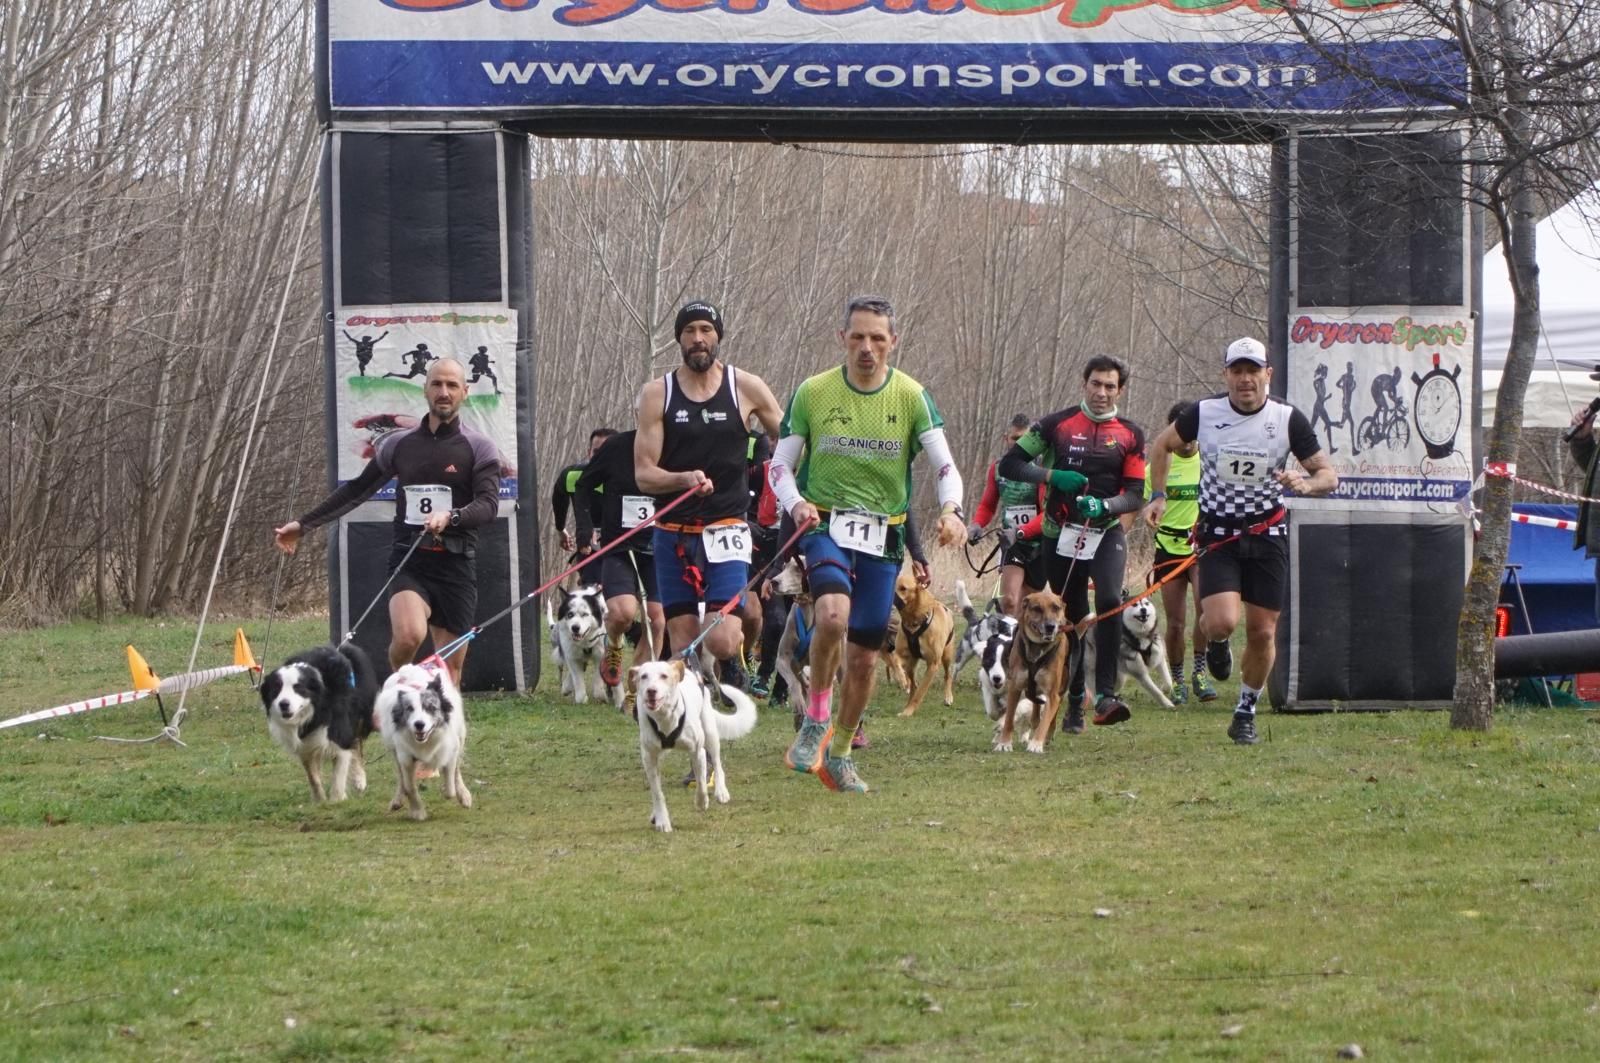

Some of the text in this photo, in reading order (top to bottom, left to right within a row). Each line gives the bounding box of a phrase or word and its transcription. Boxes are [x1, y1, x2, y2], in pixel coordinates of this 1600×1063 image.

[481, 56, 1317, 95] www.orycronsport.com
[1291, 316, 1467, 351] OrycronSport
[1230, 460, 1255, 476] 12
[420, 498, 432, 514] 8
[638, 507, 648, 520] 3
[1013, 513, 1030, 525] 10
[845, 520, 870, 541] 11
[717, 534, 744, 550] 16
